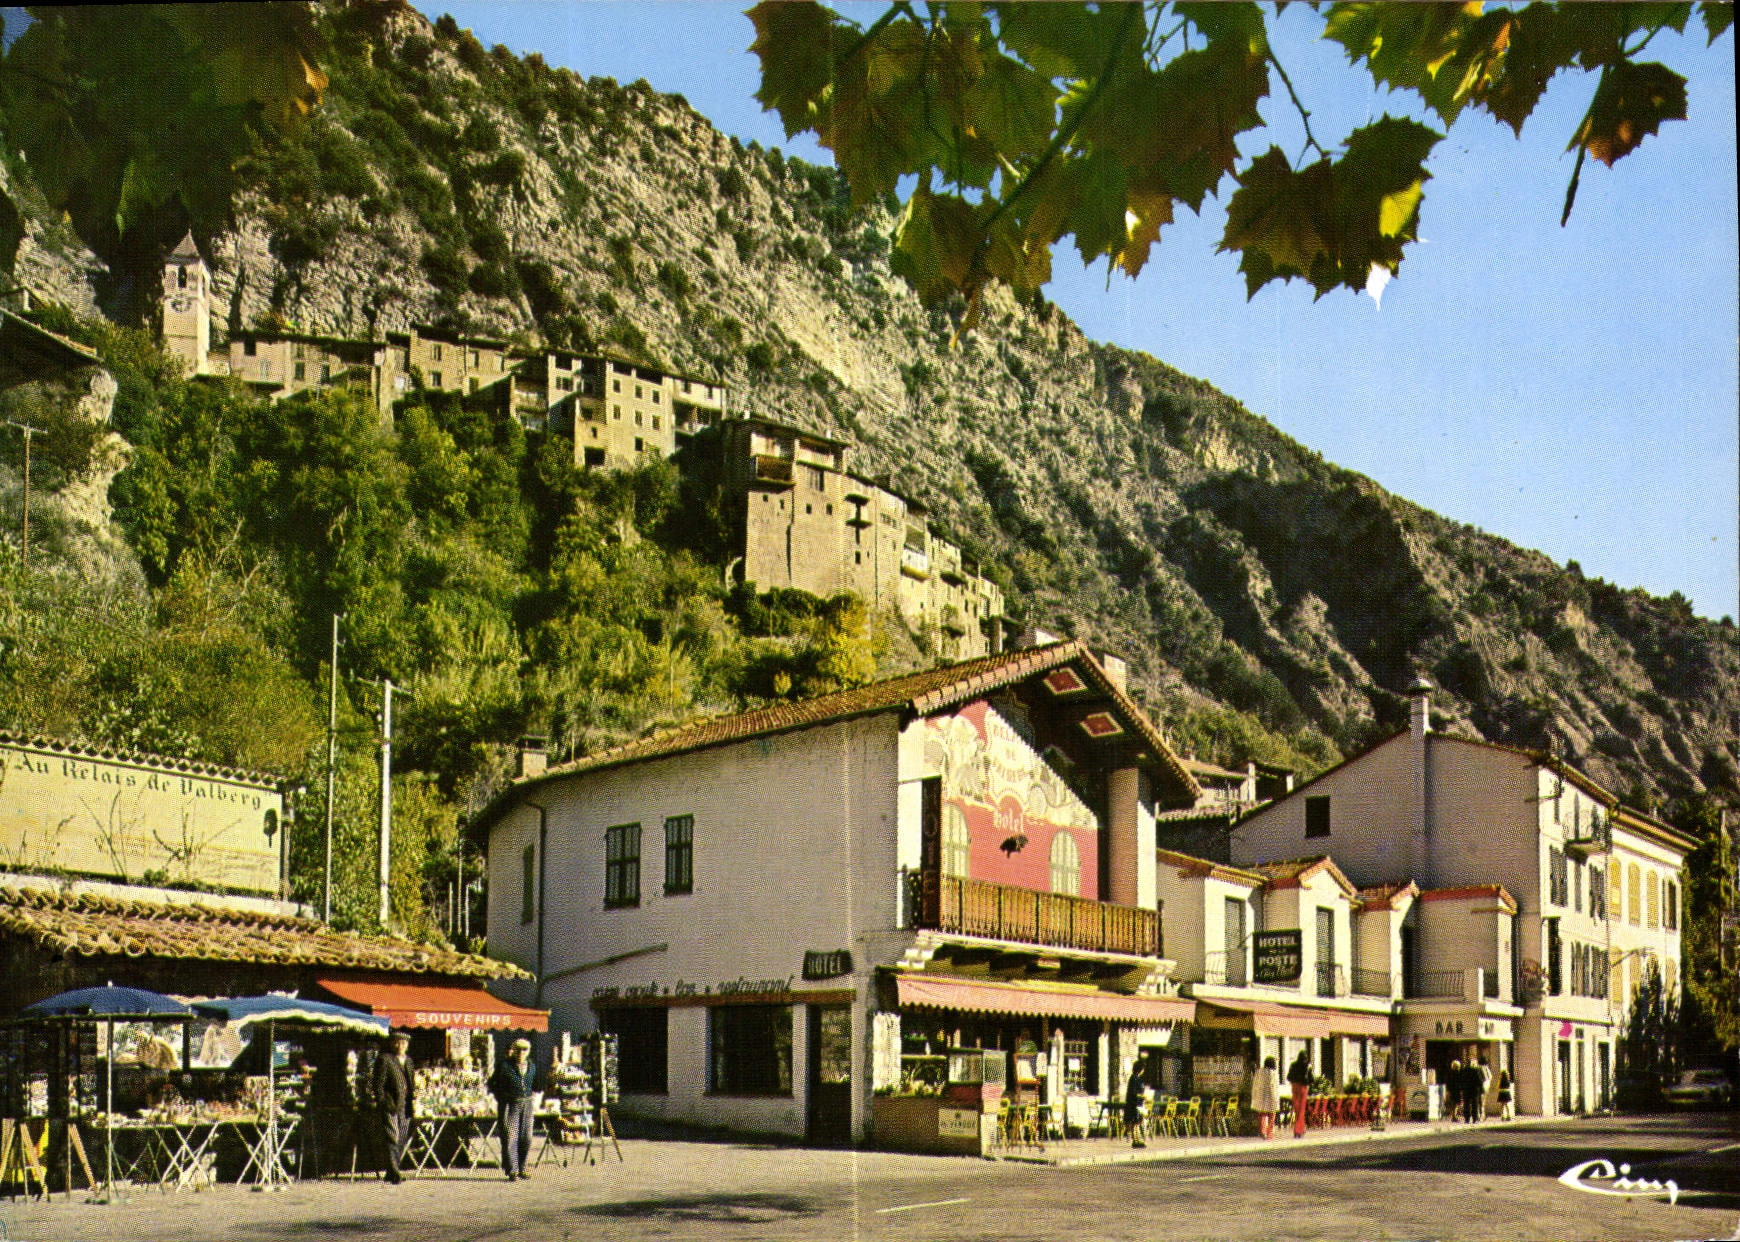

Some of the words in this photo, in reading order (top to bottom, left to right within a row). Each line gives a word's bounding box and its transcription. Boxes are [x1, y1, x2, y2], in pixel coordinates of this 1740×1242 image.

[62, 760, 137, 786] Relais
[147, 773, 171, 793] de
[180, 778, 261, 809] Valberg
[1258, 935, 1298, 949] HOTEL
[808, 953, 842, 975] HOTEL
[416, 1012, 511, 1025] SOUVENIRS
[1435, 1019, 1464, 1035] BAR
